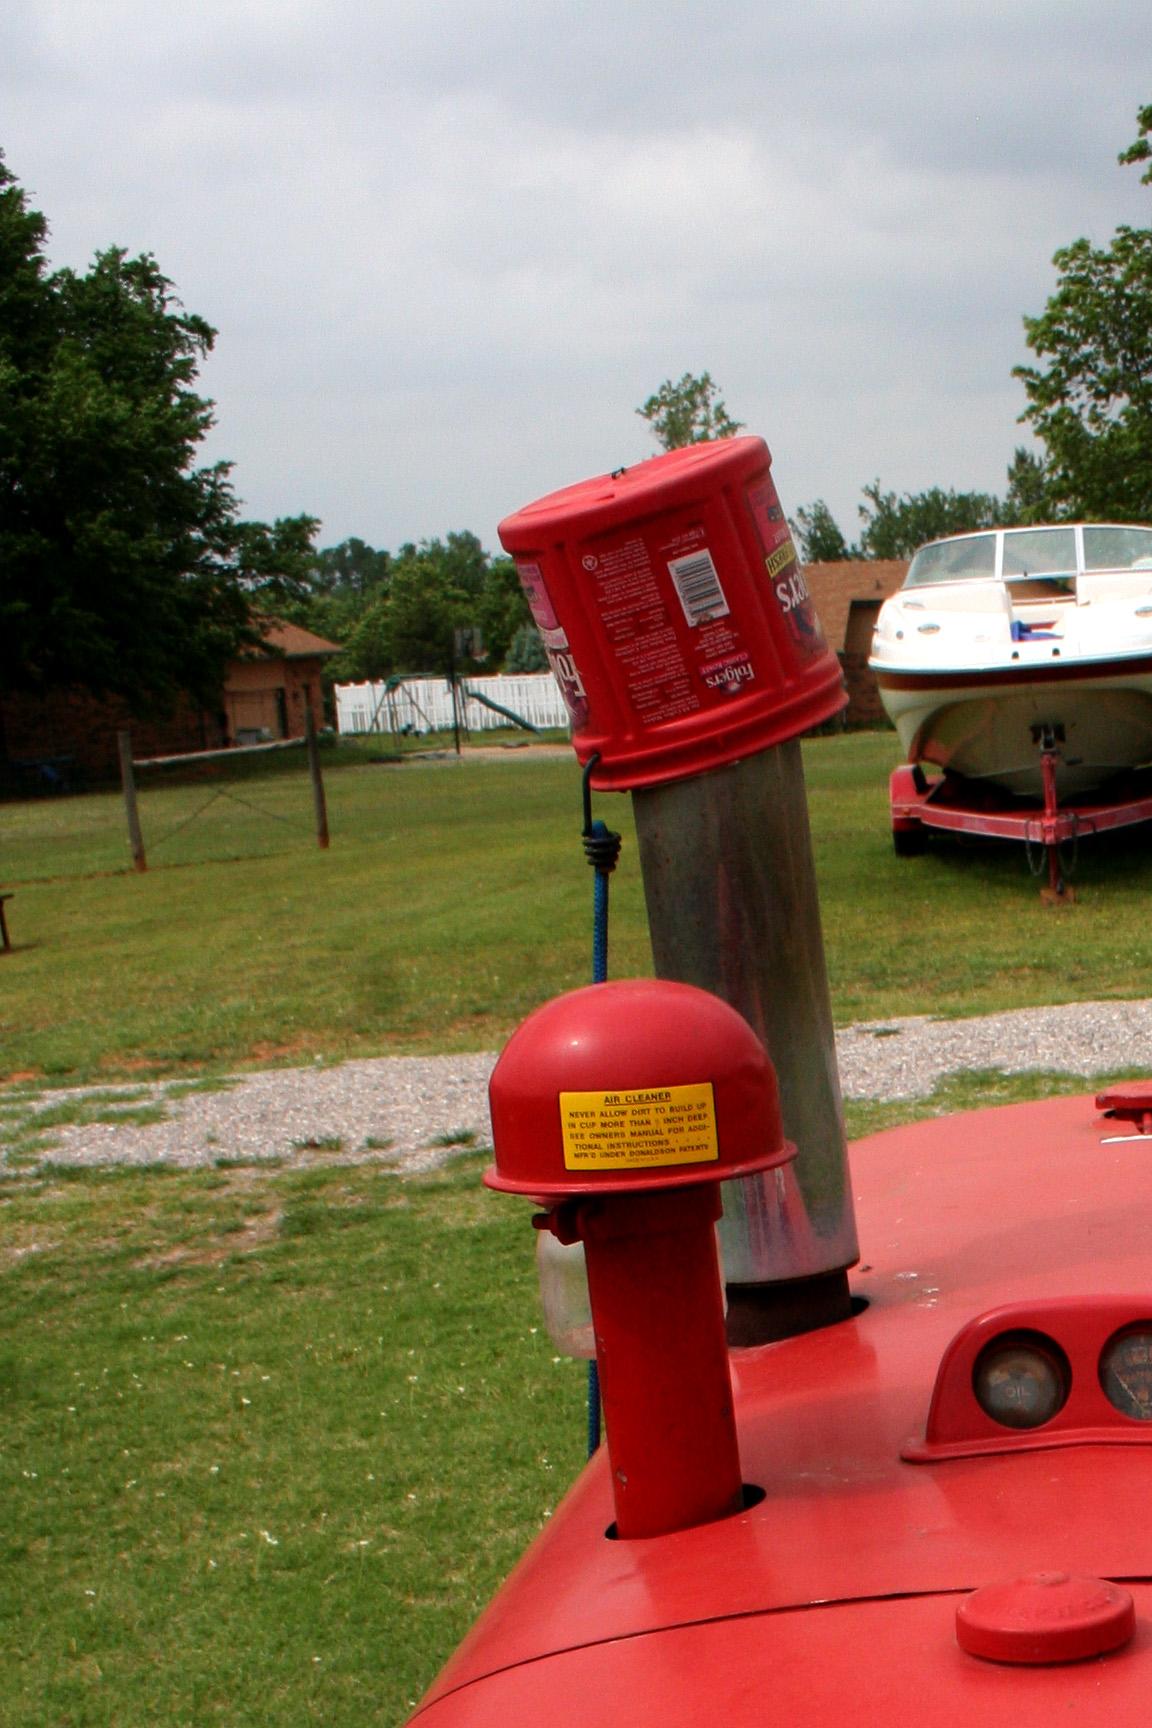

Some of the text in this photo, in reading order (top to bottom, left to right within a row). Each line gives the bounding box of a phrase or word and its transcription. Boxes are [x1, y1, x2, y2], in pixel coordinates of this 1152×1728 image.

[705, 663, 755, 688] Folgers
[604, 1092, 671, 1104] AIR CLEANER
[569, 1111, 596, 1119] NEVER
[599, 1110, 628, 1118] ALLOW
[632, 1108, 651, 1116] DIRT
[655, 1106, 665, 1114] TO
[669, 1104, 693, 1113] BUILD
[568, 1121, 576, 1129] IN
[600, 1120, 625, 1128] MORE
[629, 1119, 651, 1127] THAN
[663, 1115, 684, 1124] INCH
[630, 1129, 664, 1138] MANUAL
[668, 1126, 685, 1135] FOR
[574, 1139, 670, 1150] TIONAL INSTRUCTIONS
[600, 1150, 626, 1158] UNDER
